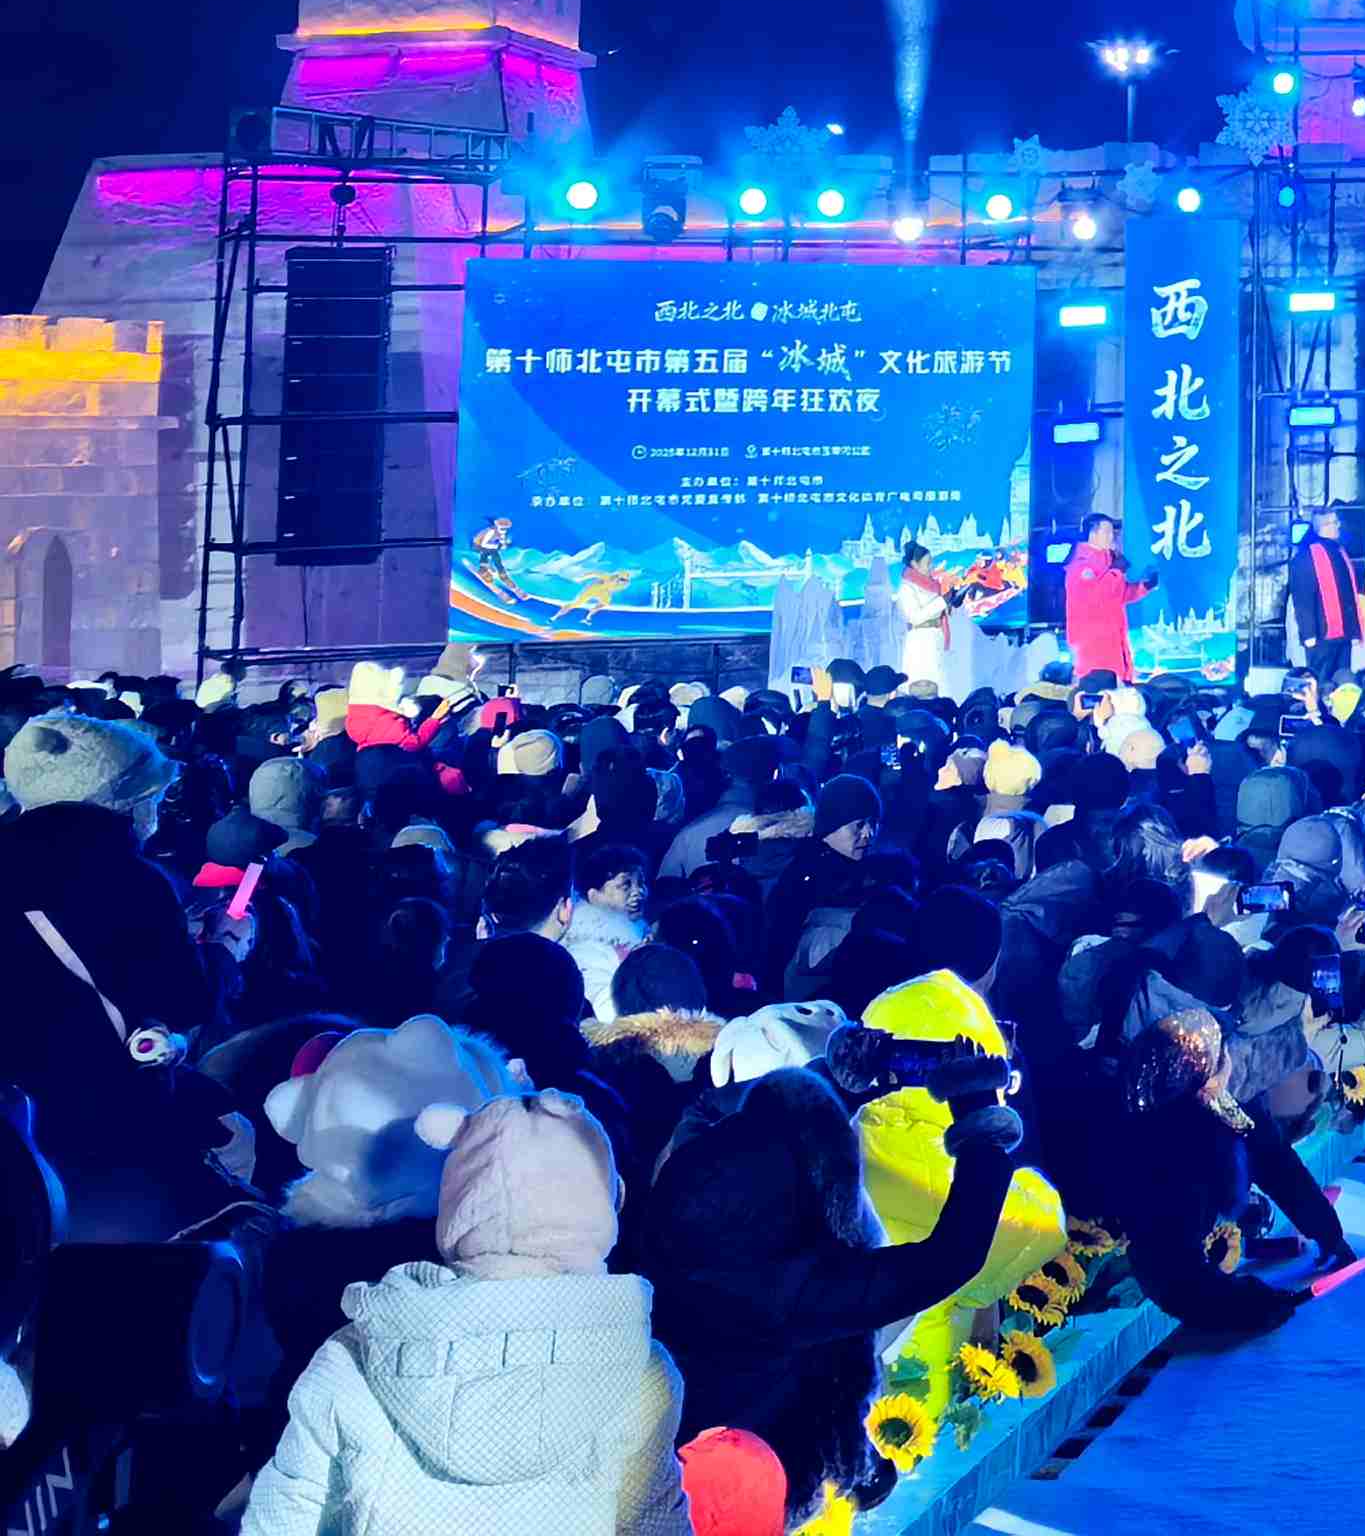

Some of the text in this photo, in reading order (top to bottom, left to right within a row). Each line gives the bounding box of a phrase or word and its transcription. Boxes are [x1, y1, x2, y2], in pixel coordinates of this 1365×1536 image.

[653, 299, 863, 325] 西北之北 冰城北屯
[626, 386, 882, 414] 开幕式暨跨年狂欢夜
[1150, 277, 1212, 562] 西北之北
